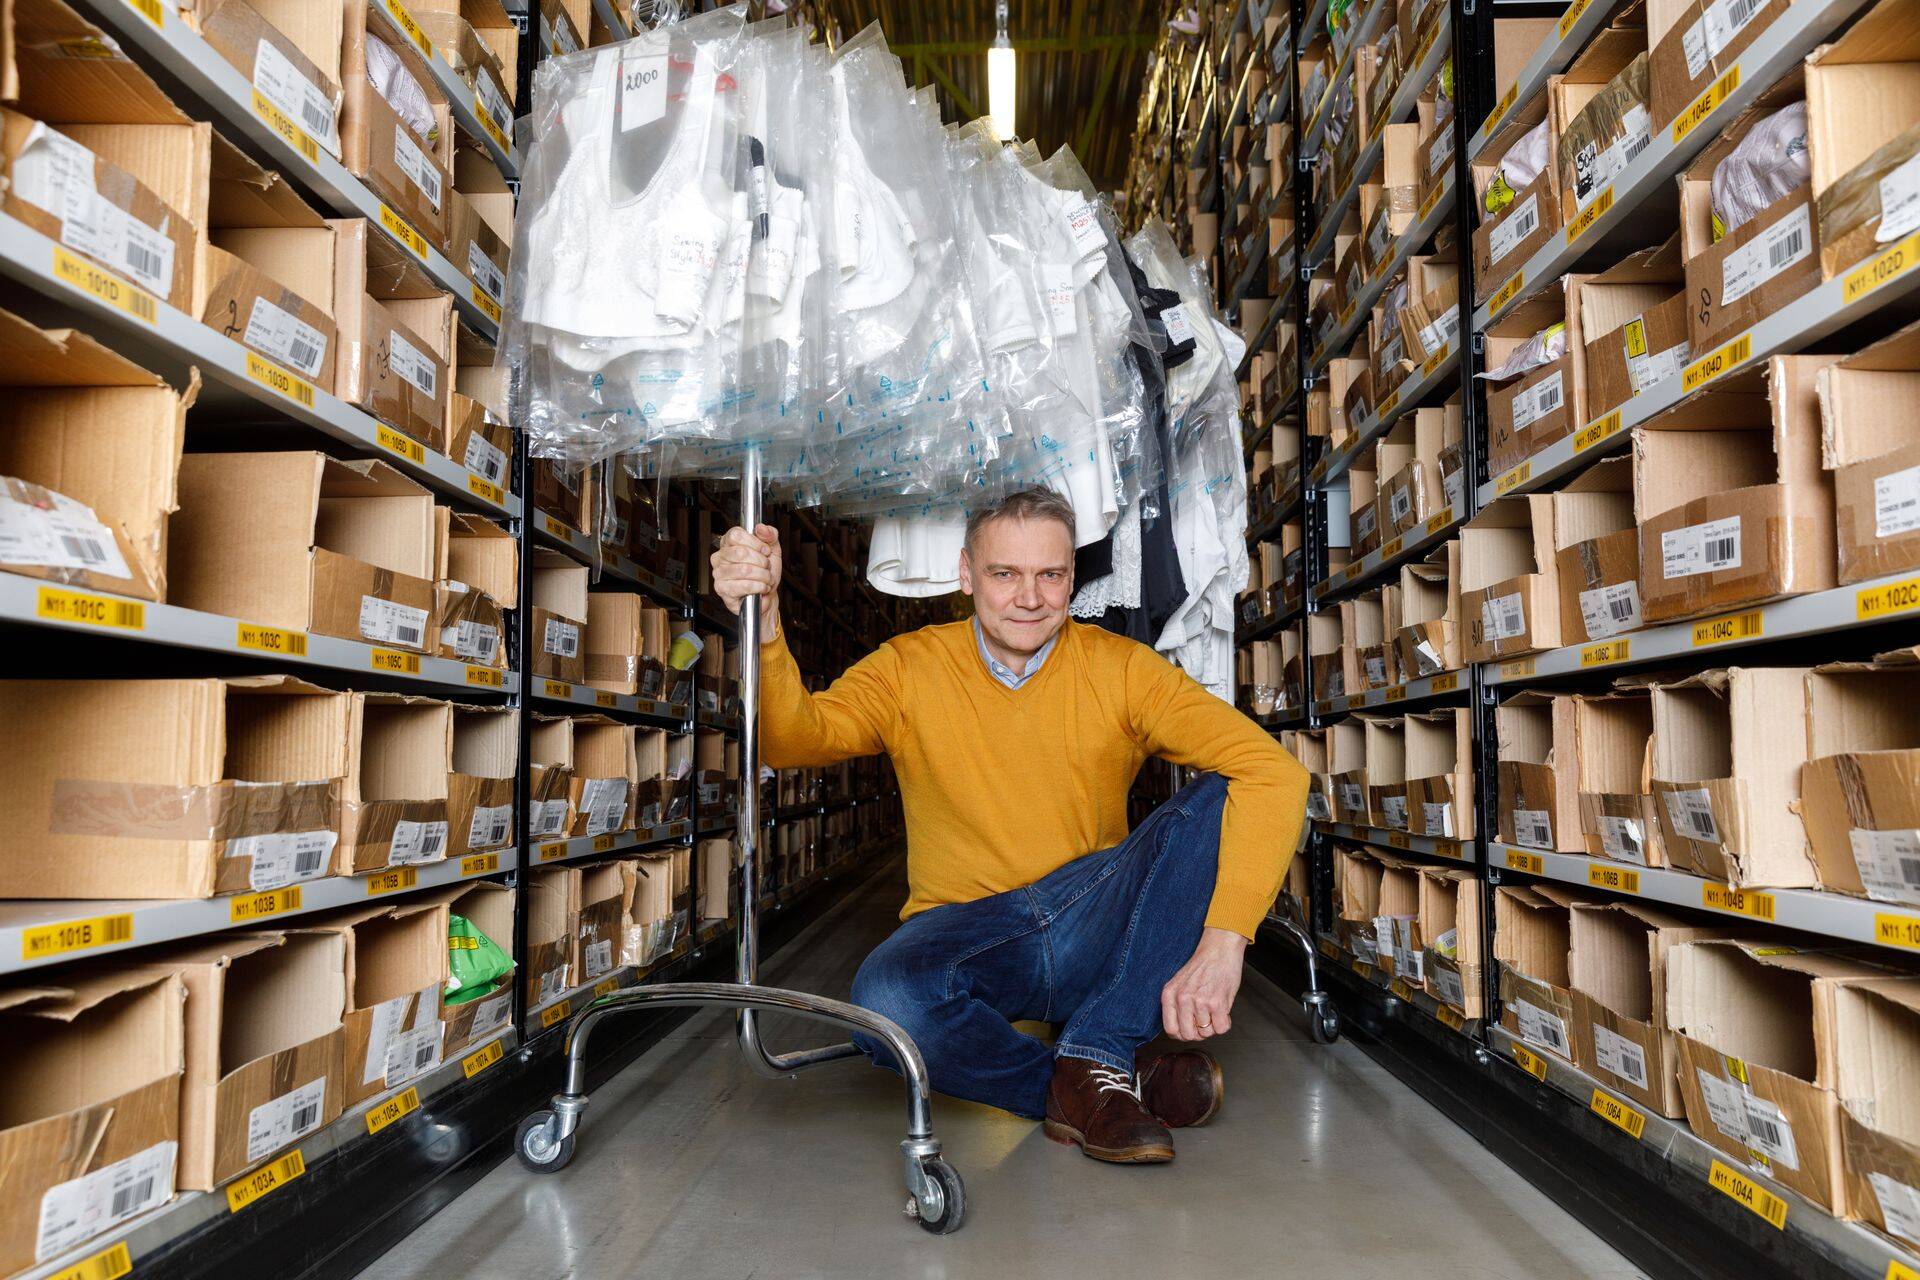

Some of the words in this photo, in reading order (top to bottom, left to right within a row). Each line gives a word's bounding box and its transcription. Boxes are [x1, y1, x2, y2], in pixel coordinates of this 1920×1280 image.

[626, 69, 658, 91] 2000
[1676, 96, 1711, 136] N11-104E
[61, 259, 120, 301] N11-101D
[1848, 250, 1904, 295] N11-102D
[1699, 288, 1712, 327] 50
[252, 361, 290, 392] N11-103D
[1686, 354, 1723, 386] N11-104D
[46, 596, 106, 621] N11-101C
[1861, 582, 1919, 612] N11-102C
[242, 633, 281, 649] N11-103C
[1696, 620, 1733, 641] N11-104C
[1583, 647, 1610, 663] N11-106C
[371, 874, 399, 891] N11-105B
[1592, 870, 1619, 886] N11-106B
[235, 895, 276, 917] N11-103B
[1706, 887, 1745, 911] N11-104B
[31, 924, 92, 951] N11-101B
[371, 1104, 400, 1128] N11-105A
[1594, 1100, 1622, 1122] N11-106A
[233, 1169, 276, 1204] N11-103A
[1714, 1169, 1754, 1206] N11-104A
